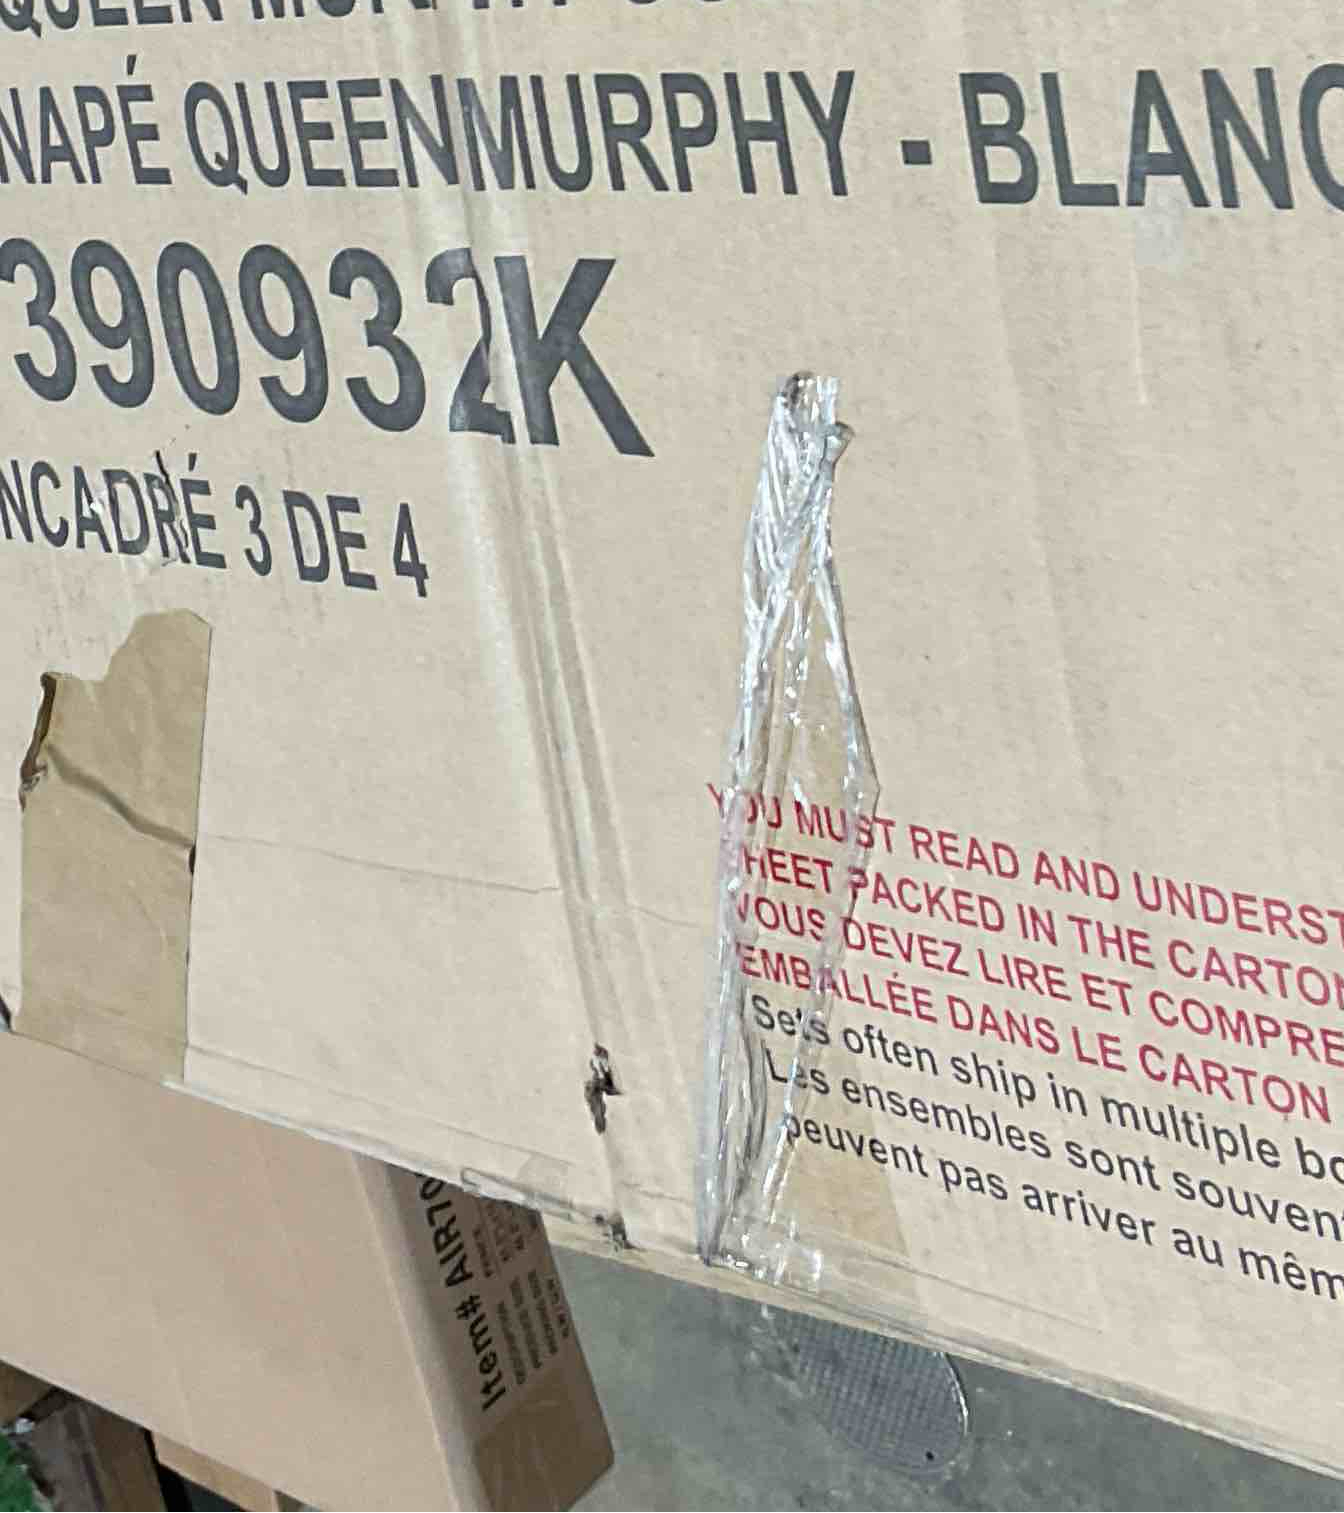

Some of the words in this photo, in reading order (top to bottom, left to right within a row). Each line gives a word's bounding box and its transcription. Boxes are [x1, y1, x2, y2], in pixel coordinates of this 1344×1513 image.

[900, 139, 932, 165] -
[235, 484, 272, 576] 3
[283, 489, 378, 590] DE
[392, 503, 429, 598] 4
[742, 842, 833, 894] HEET
[848, 867, 1005, 933] PACKED
[1018, 903, 1058, 947] IN
[1068, 914, 1155, 969] THE
[793, 799, 895, 852] MUST
[909, 824, 1020, 880] READ
[1033, 852, 1120, 901] AND
[840, 916, 969, 978] DEVEZ
[977, 949, 1072, 1002] LIRE
[1080, 972, 1133, 1018] ET
[736, 942, 938, 1024] EMBALLÉE
[948, 995, 1061, 1055] DANS
[1072, 1026, 1127, 1072] LE
[1139, 1044, 1332, 1124] CARTON
[763, 1043, 829, 1095] Les
[843, 1074, 1051, 1160] ensembles
[1065, 1141, 1160, 1191] sont
[844, 1025, 938, 1076] often
[951, 1053, 1037, 1108] ship
[1049, 1073, 1087, 1116] in
[1103, 1096, 1281, 1169] multiple
[416, 1172, 474, 1287] AIR70
[785, 1113, 929, 1179] peuvent
[939, 1157, 1008, 1201] pas
[1023, 1183, 1154, 1247] arriver
[1172, 1227, 1224, 1266] au
[454, 1295, 506, 1411] Item#
